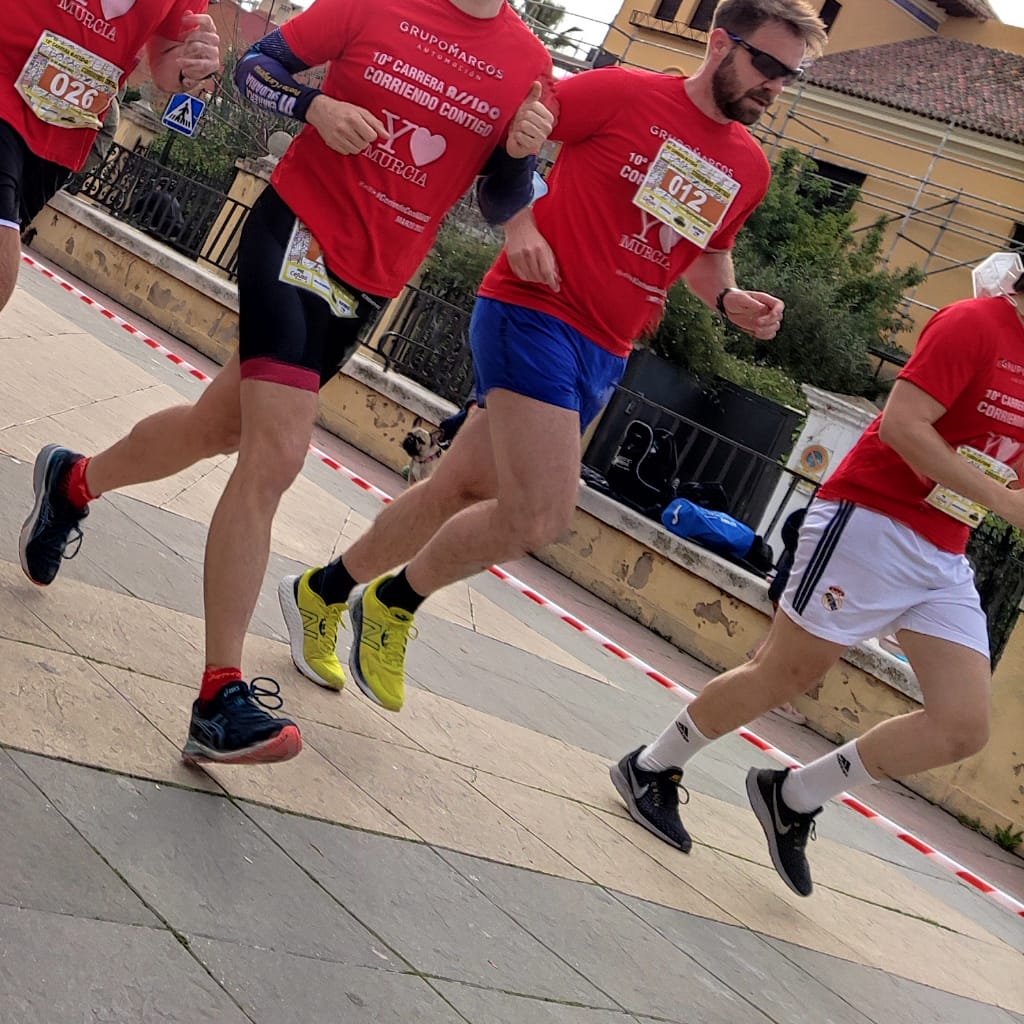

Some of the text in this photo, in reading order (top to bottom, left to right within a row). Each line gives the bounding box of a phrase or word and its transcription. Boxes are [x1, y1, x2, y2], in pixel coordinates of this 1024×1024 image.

[50, 72, 99, 109] 026
[392, 59, 444, 94] CARRERA
[363, 66, 494, 137] CORRIENDO CONTIGO
[362, 144, 428, 188] MURCIA
[668, 175, 708, 213] 012
